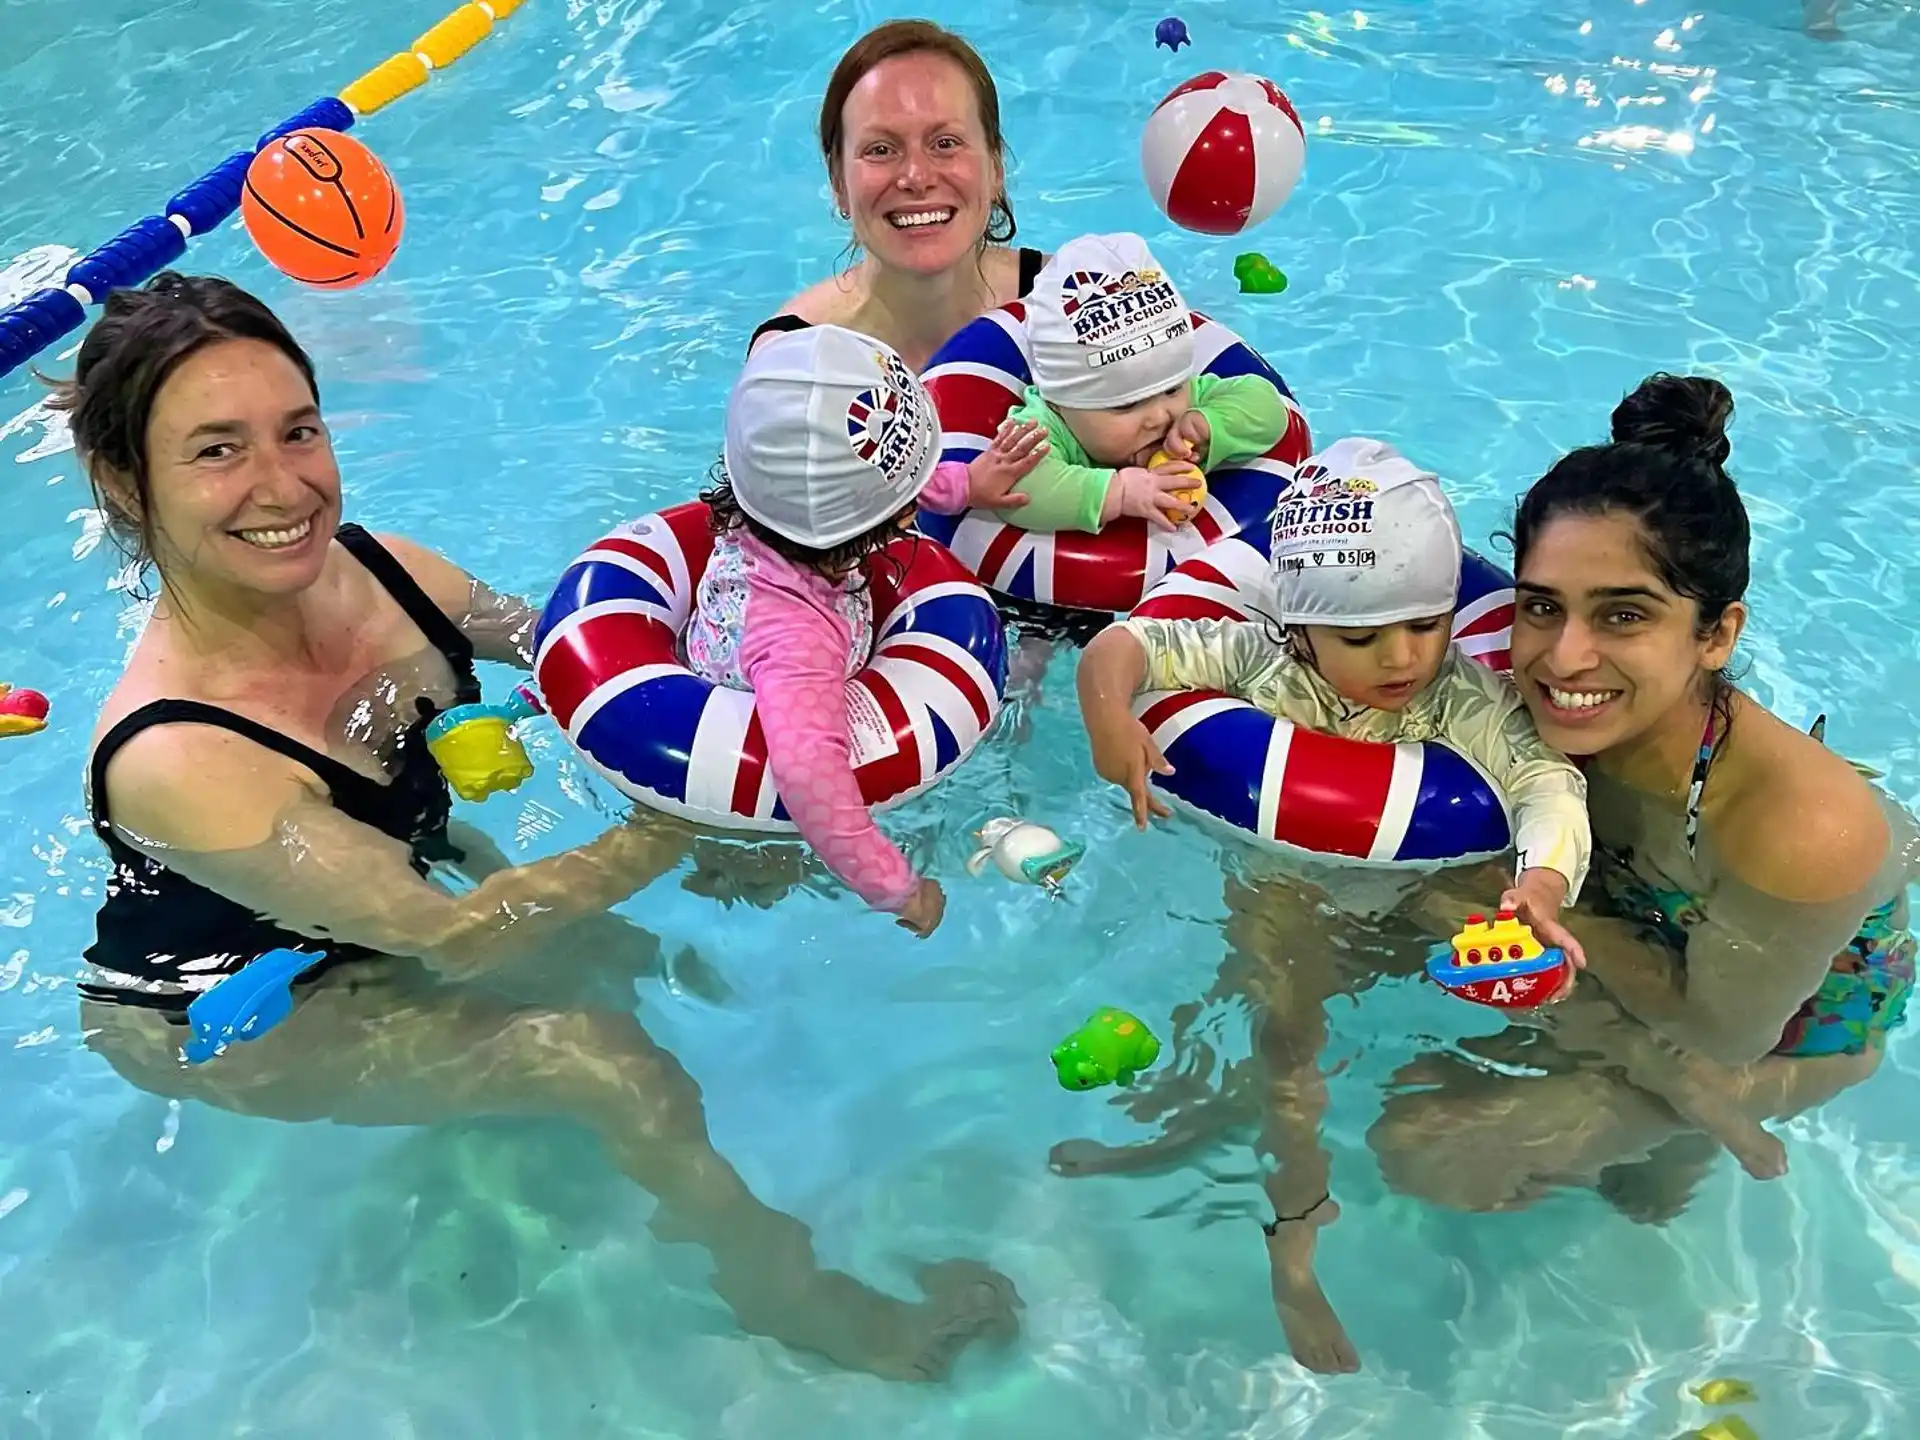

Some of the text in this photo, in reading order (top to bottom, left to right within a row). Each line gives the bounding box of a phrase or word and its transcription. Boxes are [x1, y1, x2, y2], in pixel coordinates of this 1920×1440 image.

[1072, 282, 1175, 337] BRITISH
[1078, 321, 1121, 346] SWIM
[1124, 298, 1178, 327] SCHOOL
[1275, 500, 1375, 531] BRITISH
[1301, 521, 1372, 536] SCHOOL
[1491, 980, 1512, 1003] 4
